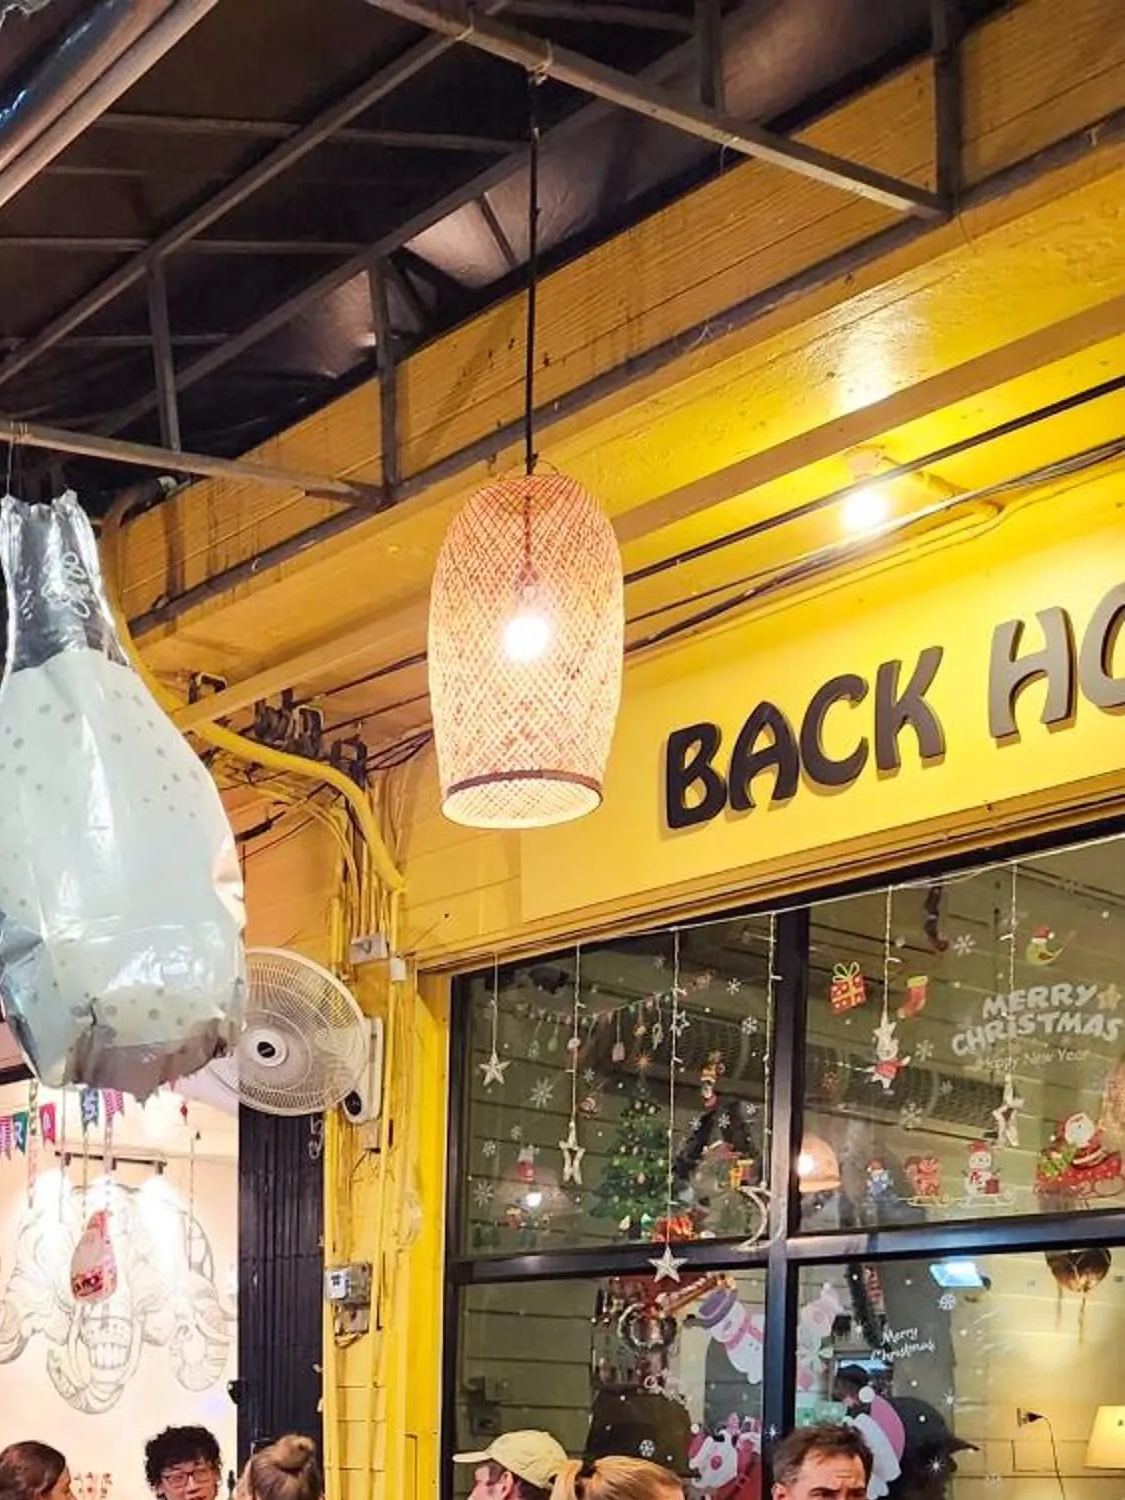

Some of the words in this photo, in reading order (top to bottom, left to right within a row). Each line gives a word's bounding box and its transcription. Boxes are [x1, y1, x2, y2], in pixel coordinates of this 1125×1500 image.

[666, 645, 946, 829] BACK
[988, 583, 1125, 738] HO
[983, 983, 1097, 1019] MERRY
[952, 1011, 1123, 1056] CHRISTMAS
